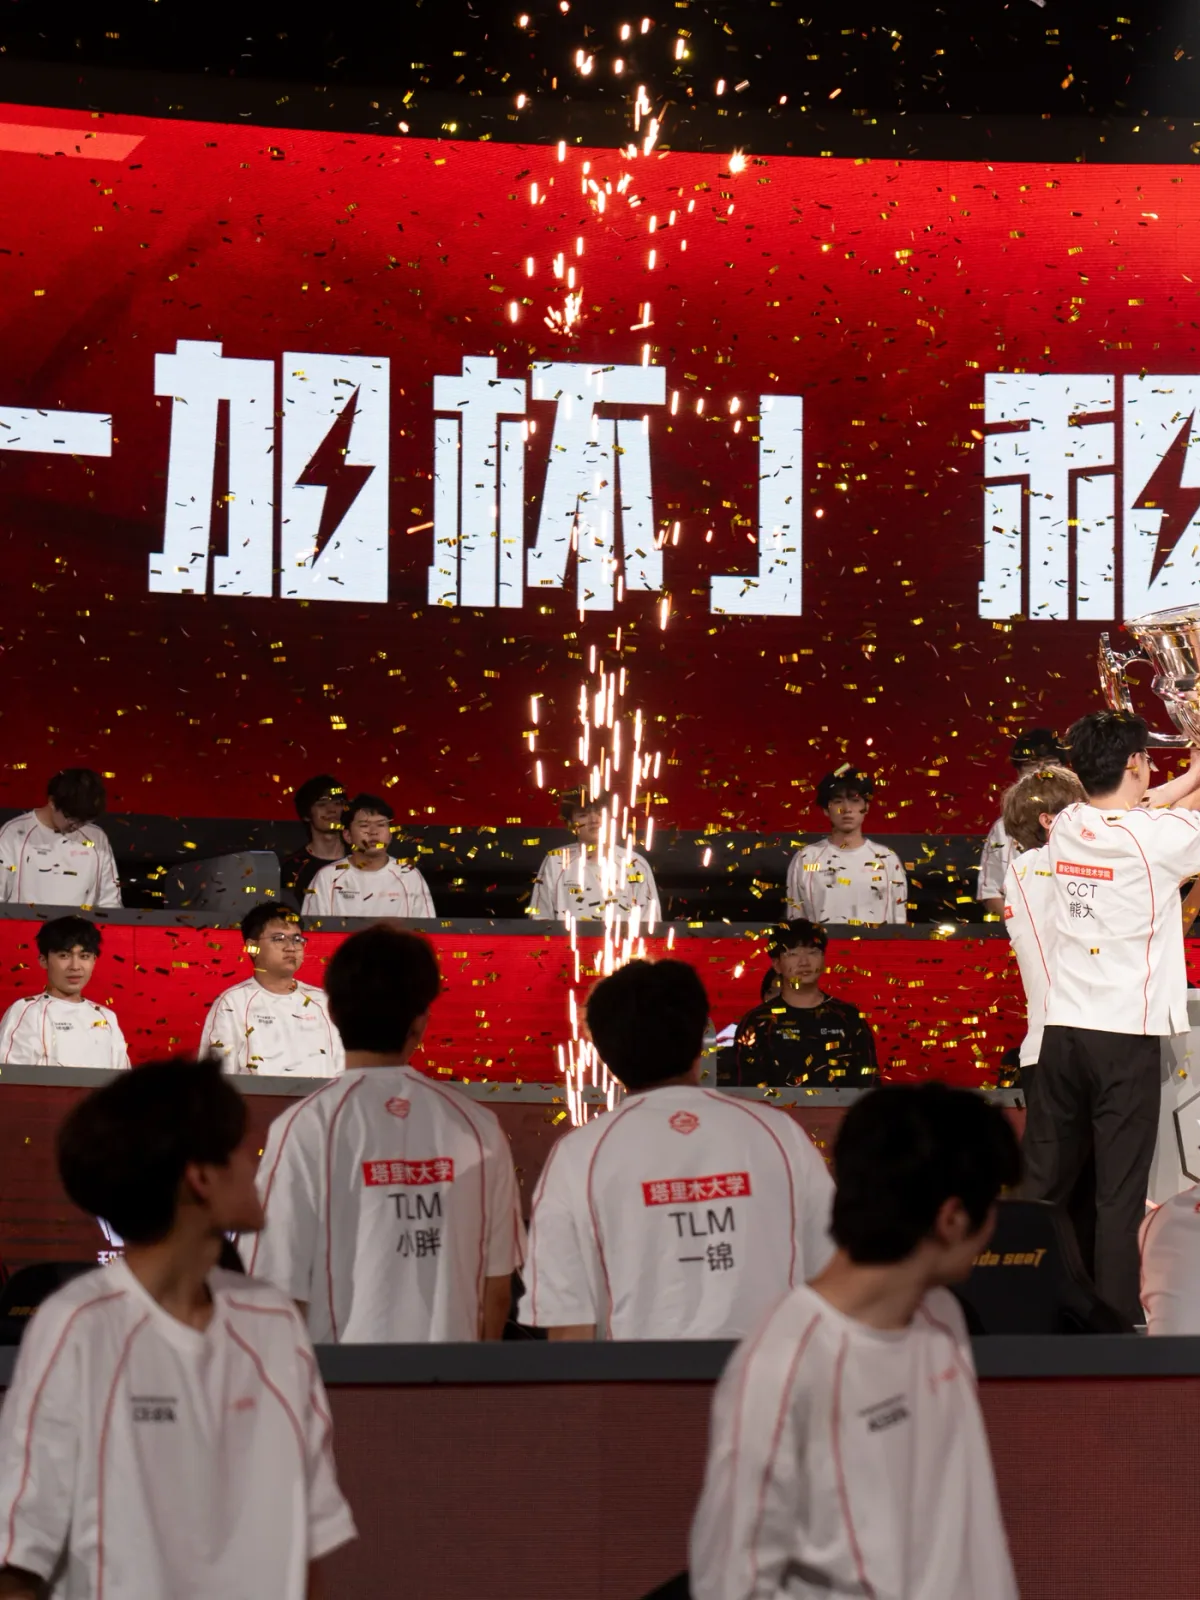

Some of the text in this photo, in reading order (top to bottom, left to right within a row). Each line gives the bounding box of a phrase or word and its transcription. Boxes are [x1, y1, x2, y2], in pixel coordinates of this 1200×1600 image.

[1066, 882, 1098, 898] CCT
[1069, 901, 1095, 919] 熊大
[370, 1160, 452, 1184] 塔里木大学
[650, 1174, 745, 1204] 塔里木大学
[388, 1192, 442, 1220] TLM
[668, 1206, 736, 1237] TLM
[396, 1227, 441, 1258] 小胖
[678, 1242, 735, 1272] 一锦
